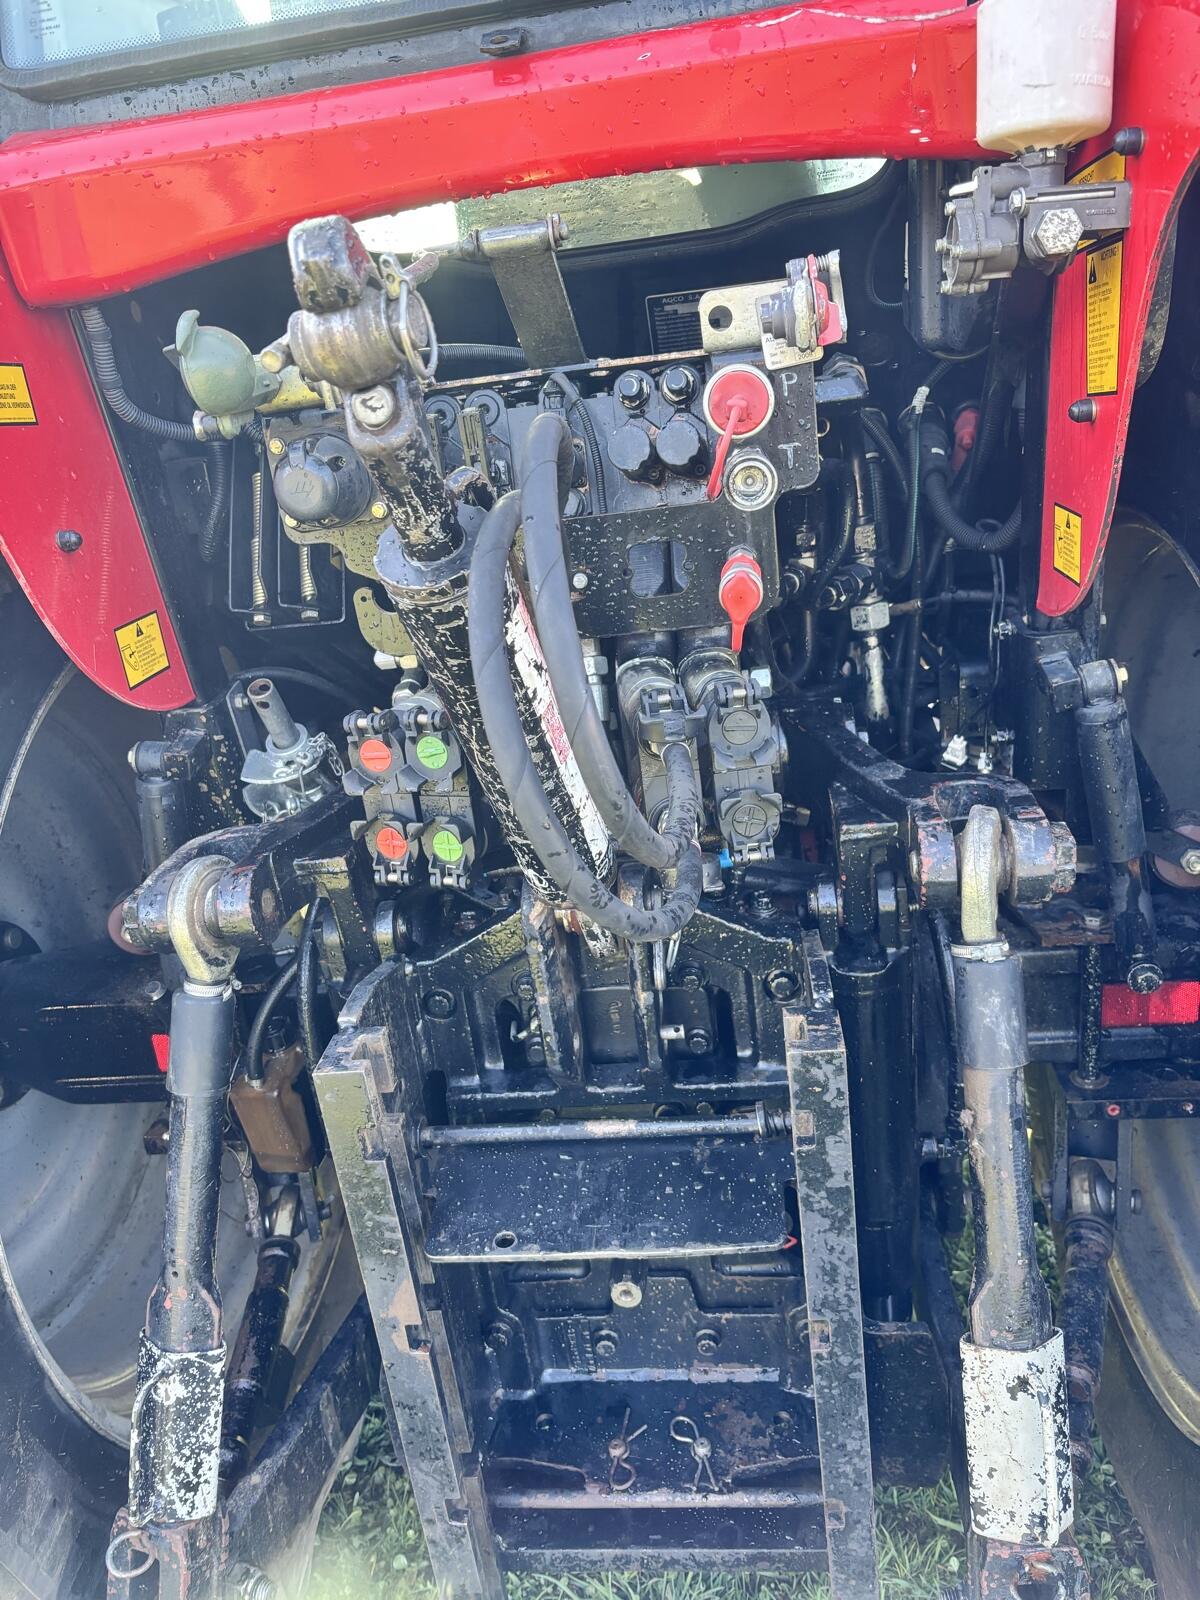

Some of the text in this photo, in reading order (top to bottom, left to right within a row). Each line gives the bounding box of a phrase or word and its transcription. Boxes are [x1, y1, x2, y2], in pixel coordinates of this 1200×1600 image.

[662, 295, 684, 304] AGCO
[781, 372, 798, 397] P
[777, 442, 802, 469] T
